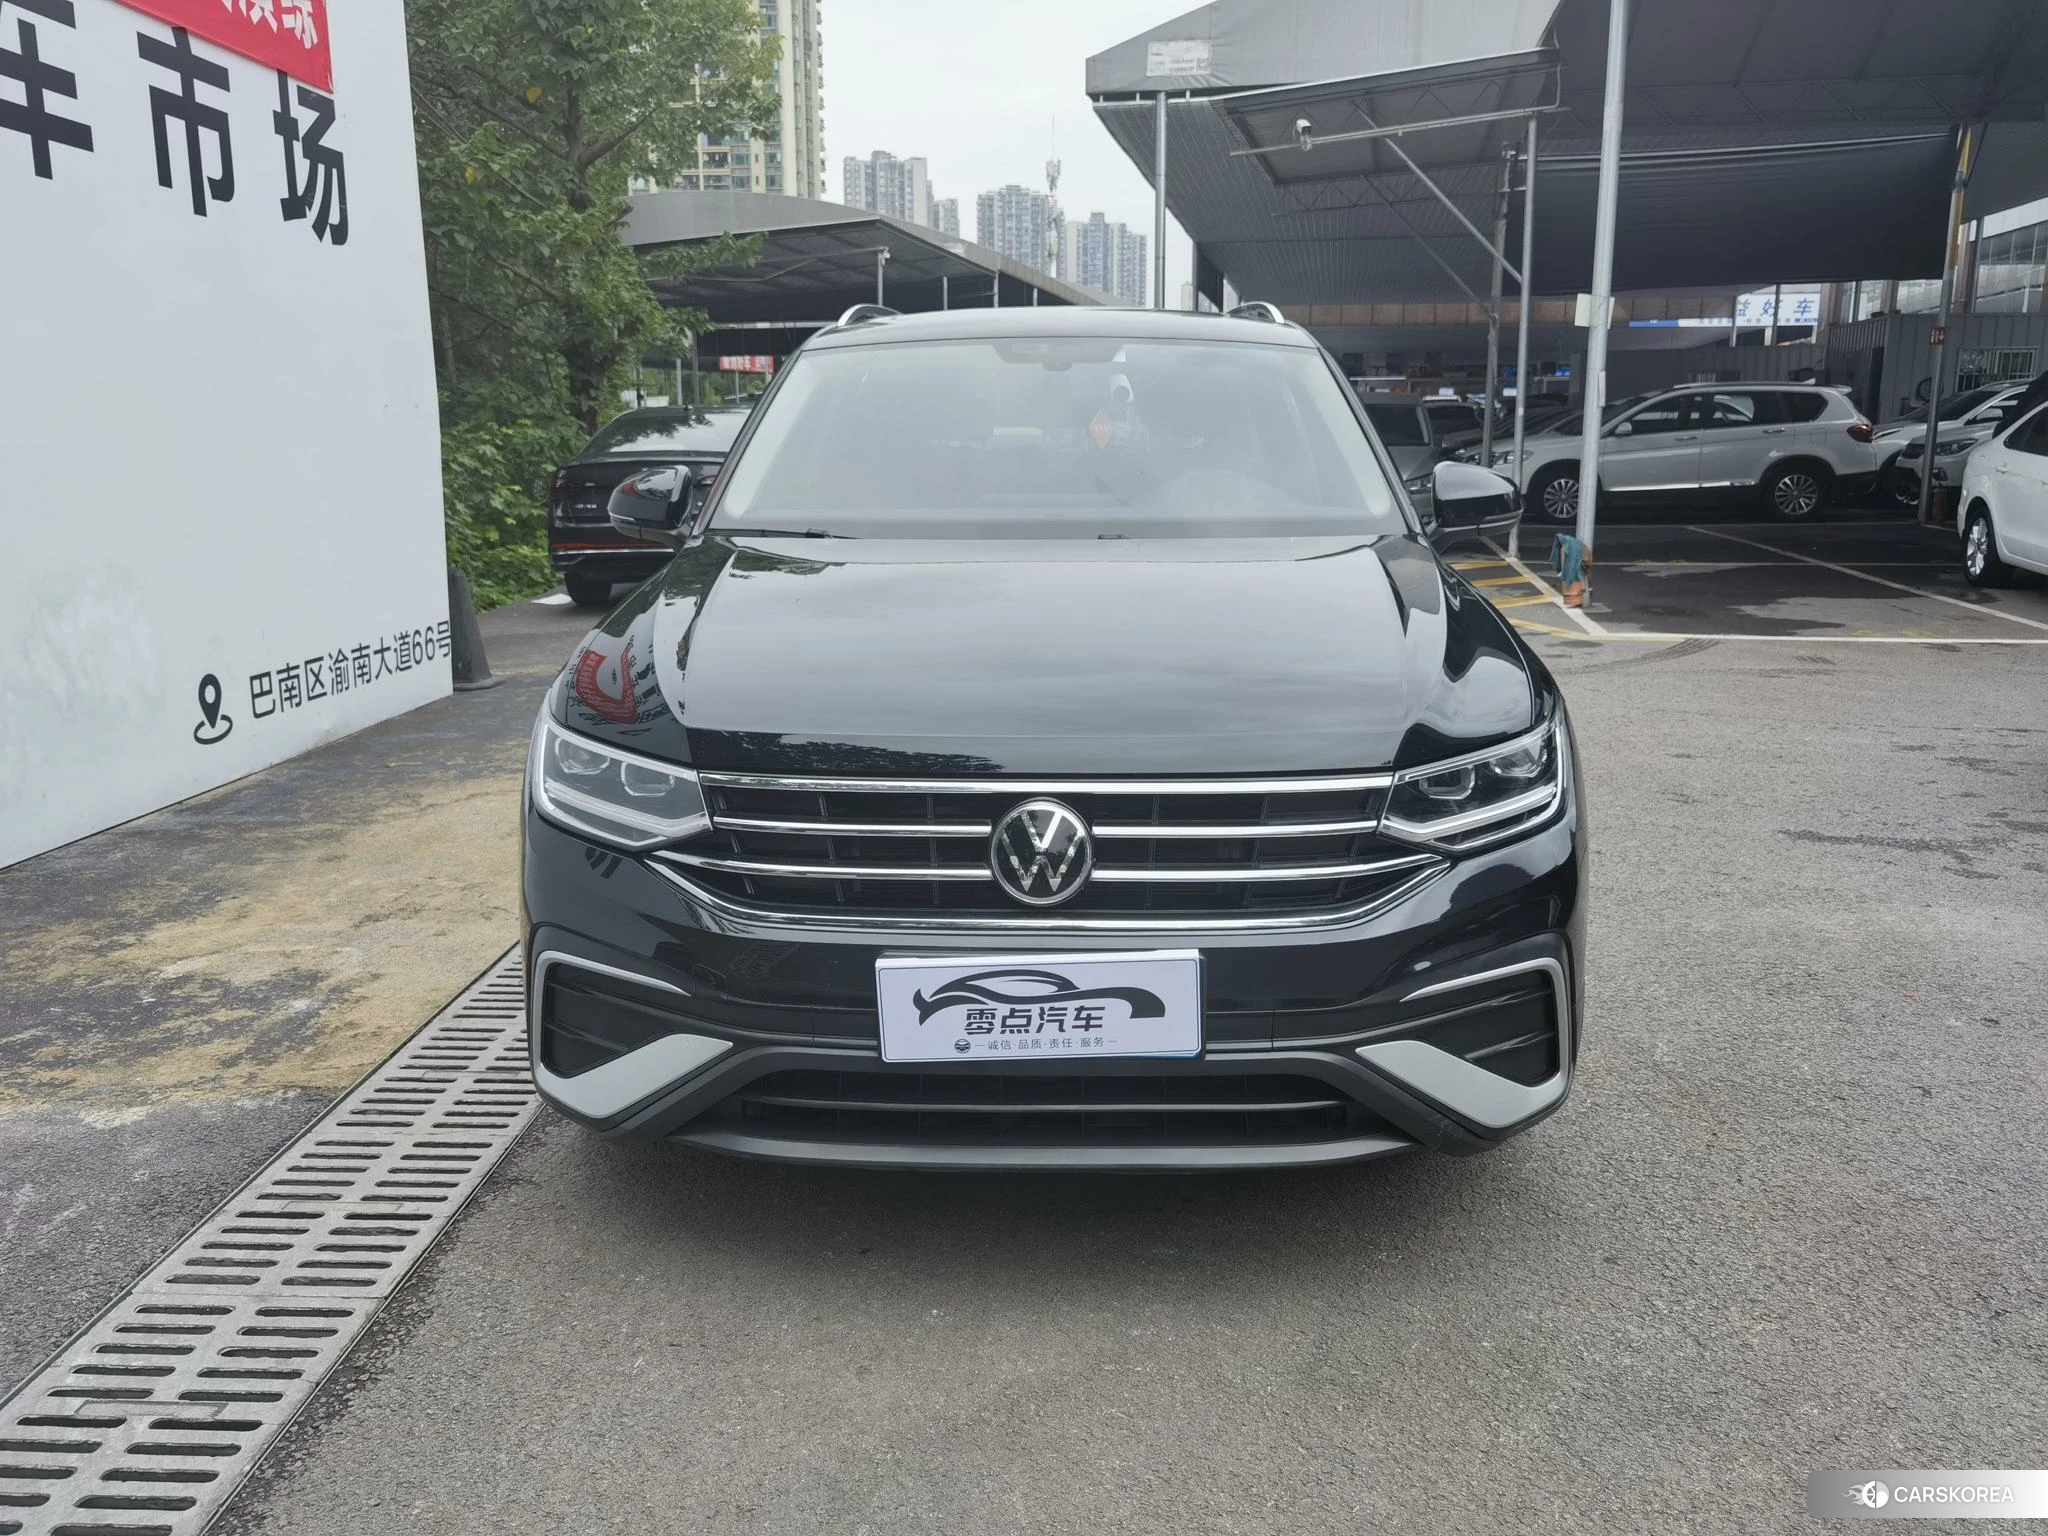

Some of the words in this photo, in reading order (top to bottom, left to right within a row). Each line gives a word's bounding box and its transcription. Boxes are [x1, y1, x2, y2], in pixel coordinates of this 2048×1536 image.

[249, 619, 451, 719] 巴南区渝南大道66号
[964, 1005, 1106, 1035] 零点汽车
